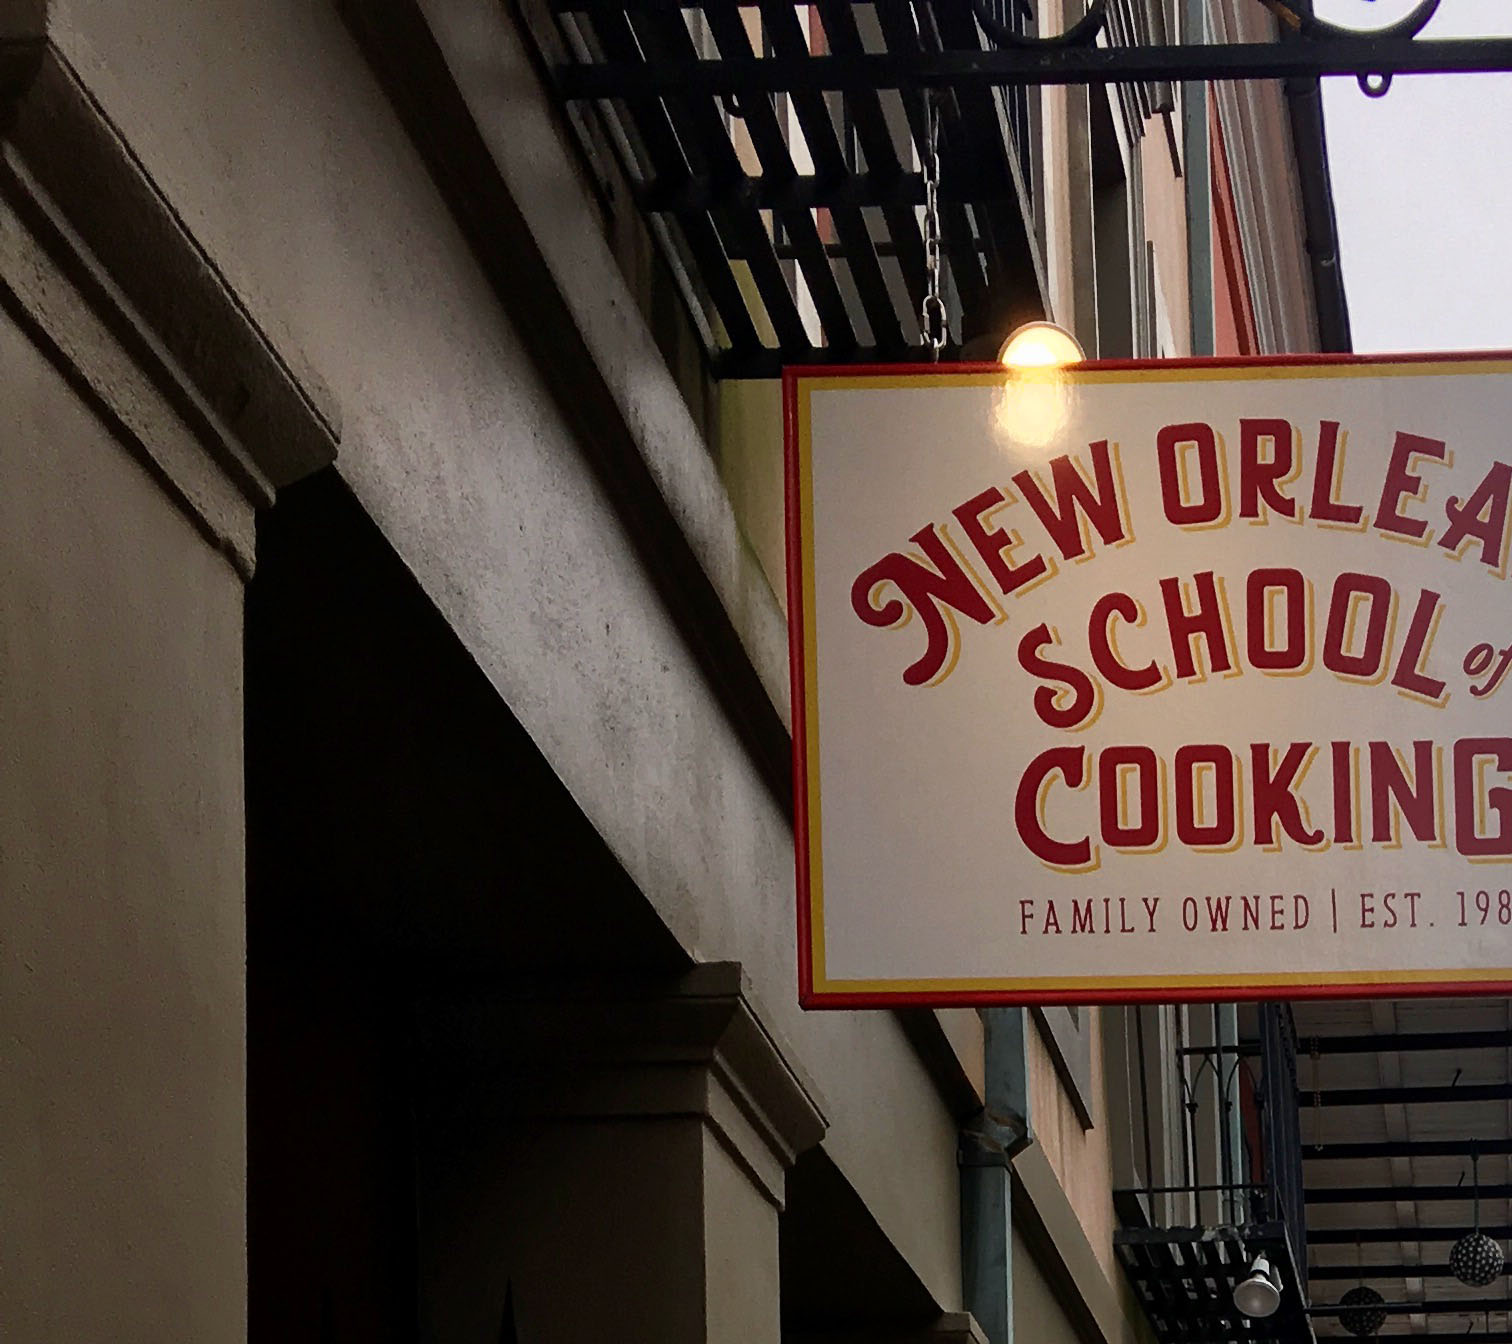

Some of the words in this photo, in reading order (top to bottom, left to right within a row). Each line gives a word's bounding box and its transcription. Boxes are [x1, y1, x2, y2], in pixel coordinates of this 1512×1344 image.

[851, 438, 1132, 687] NEW
[1016, 567, 1450, 730] SCHOOL
[1019, 895, 1161, 936] FAMILY
[1181, 894, 1311, 932] OWNED
[1359, 891, 1435, 929] EST.
